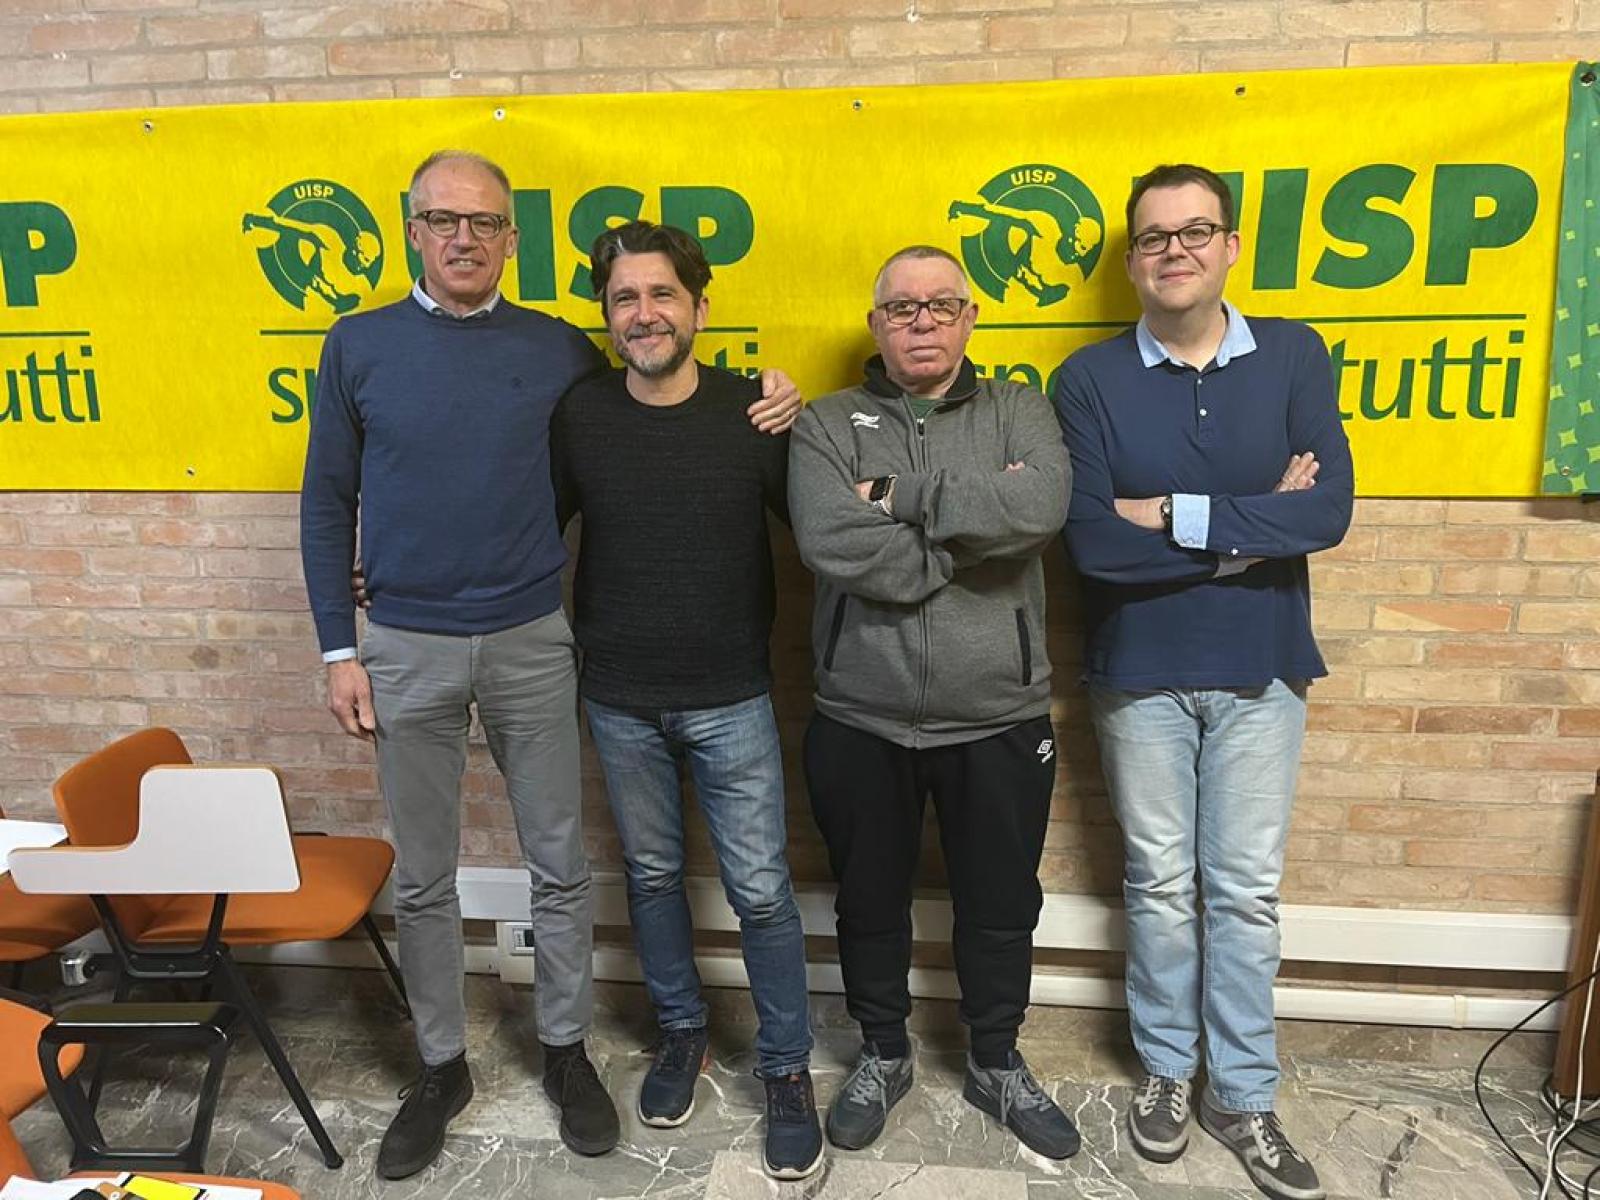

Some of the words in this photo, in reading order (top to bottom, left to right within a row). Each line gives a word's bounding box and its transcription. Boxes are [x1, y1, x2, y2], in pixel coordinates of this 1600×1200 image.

[293, 183, 334, 199] UISP
[1010, 168, 1057, 186] UISP
[400, 185, 755, 302] ISP
[1132, 163, 1539, 290] ISP
[0, 345, 100, 422] utti
